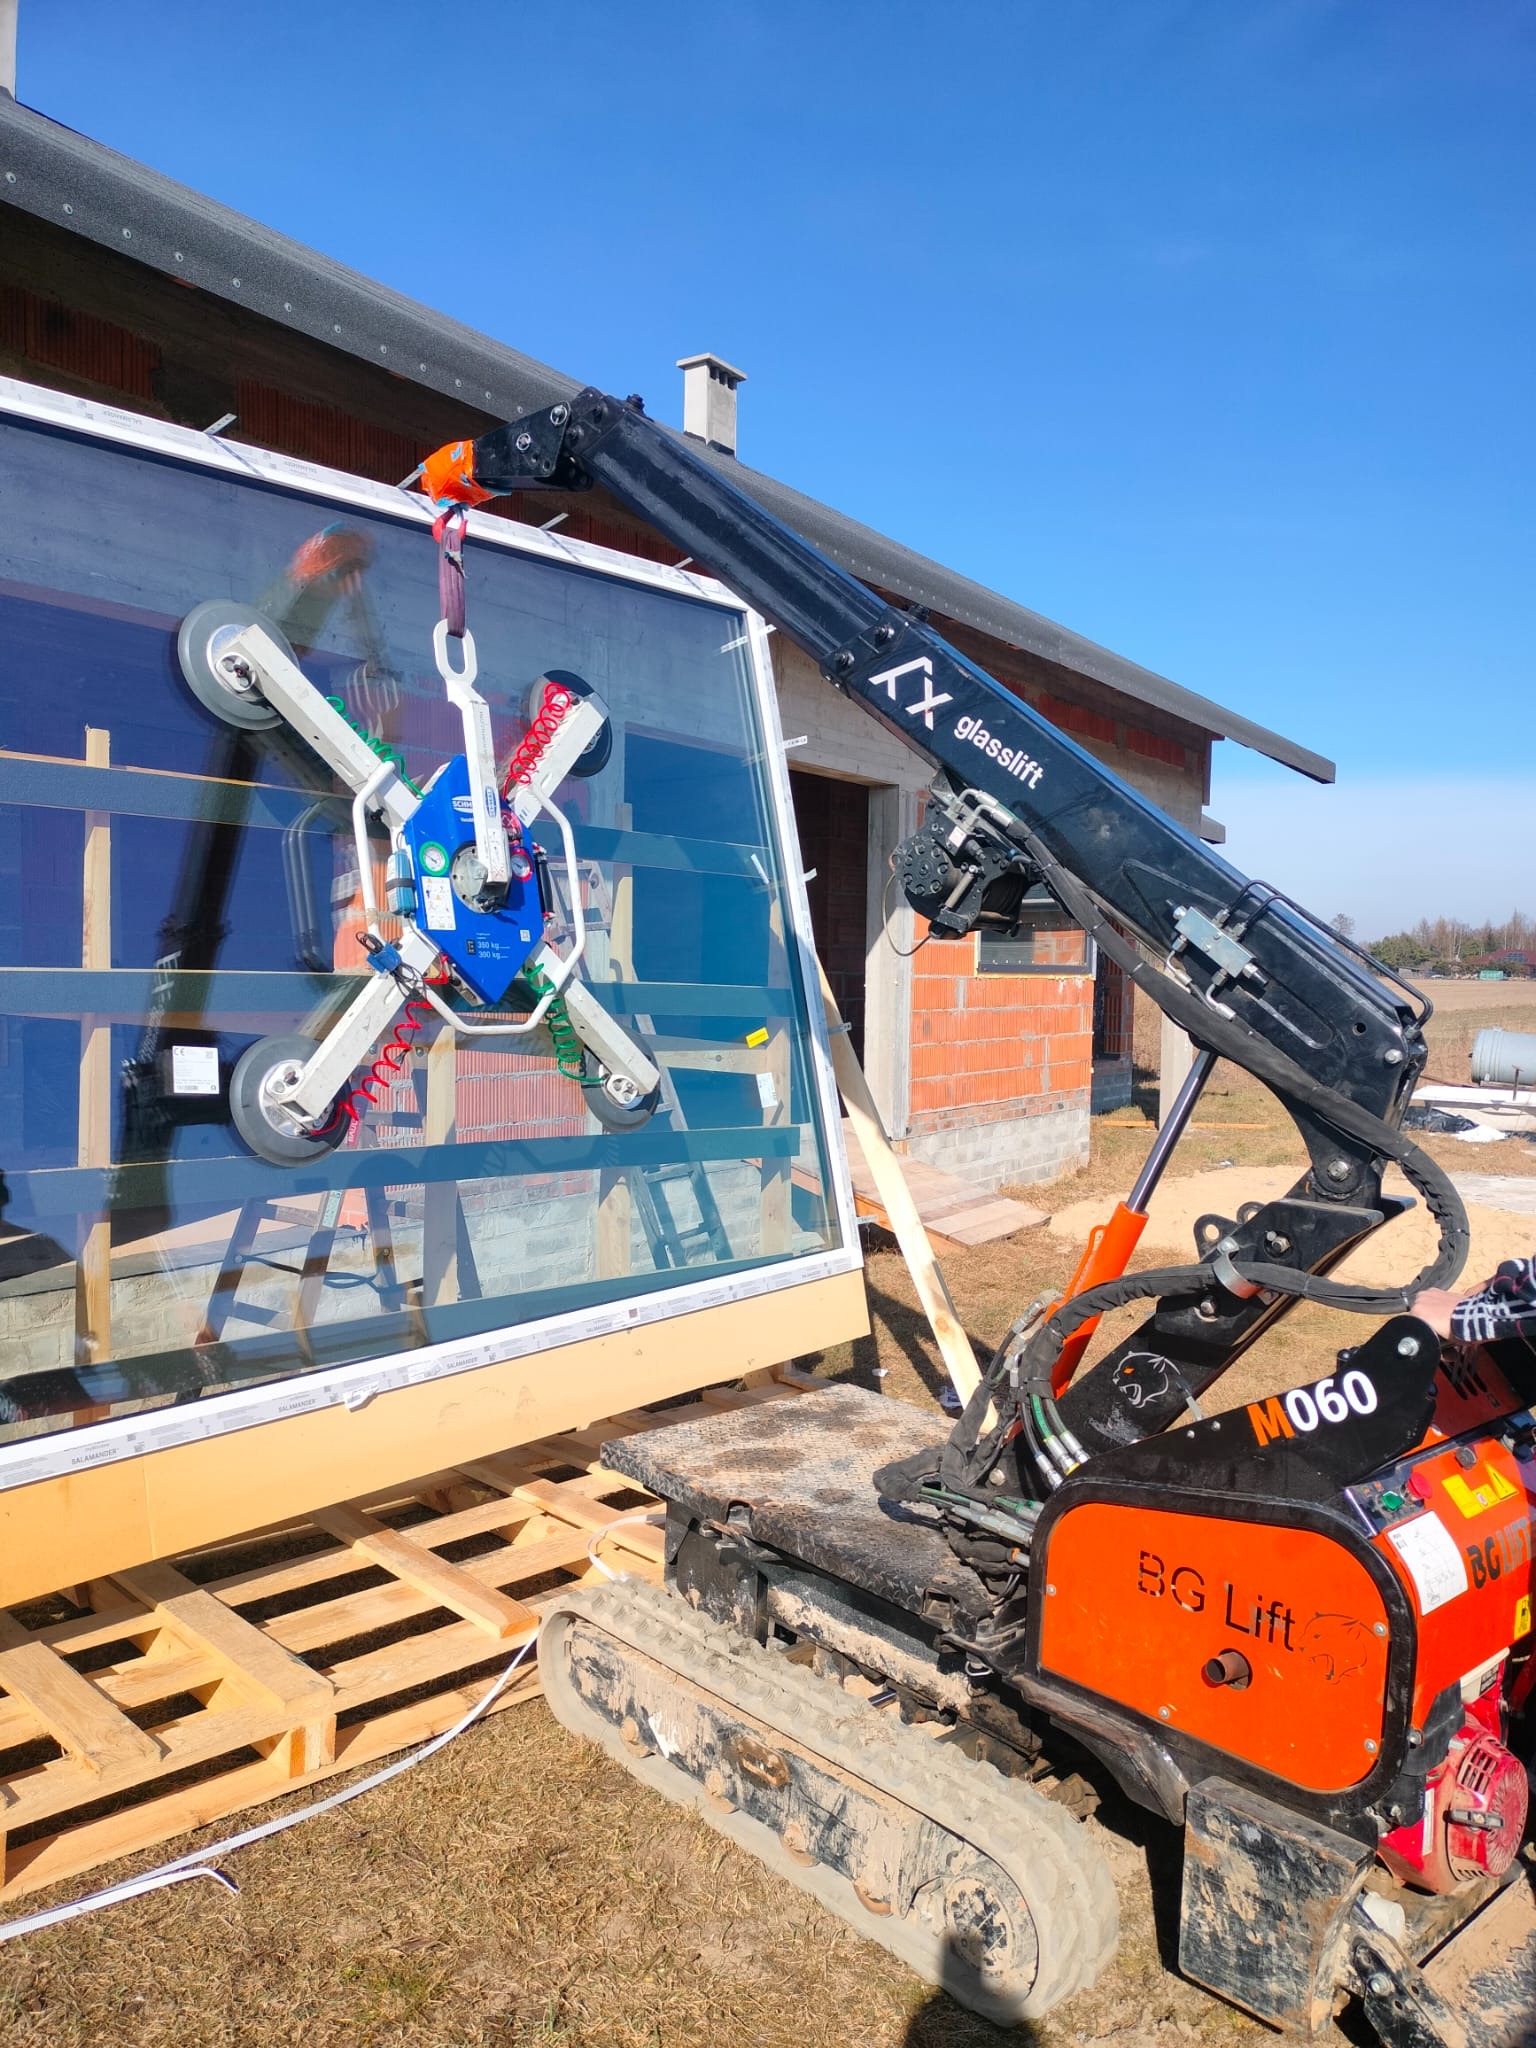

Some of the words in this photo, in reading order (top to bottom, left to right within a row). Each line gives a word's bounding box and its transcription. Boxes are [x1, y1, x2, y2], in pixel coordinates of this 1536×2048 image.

[954, 716, 1044, 789] glasslift
[1247, 1370, 1378, 1447] M060
[1138, 1550, 1205, 1612] BG
[1223, 1579, 1296, 1652] Lift
